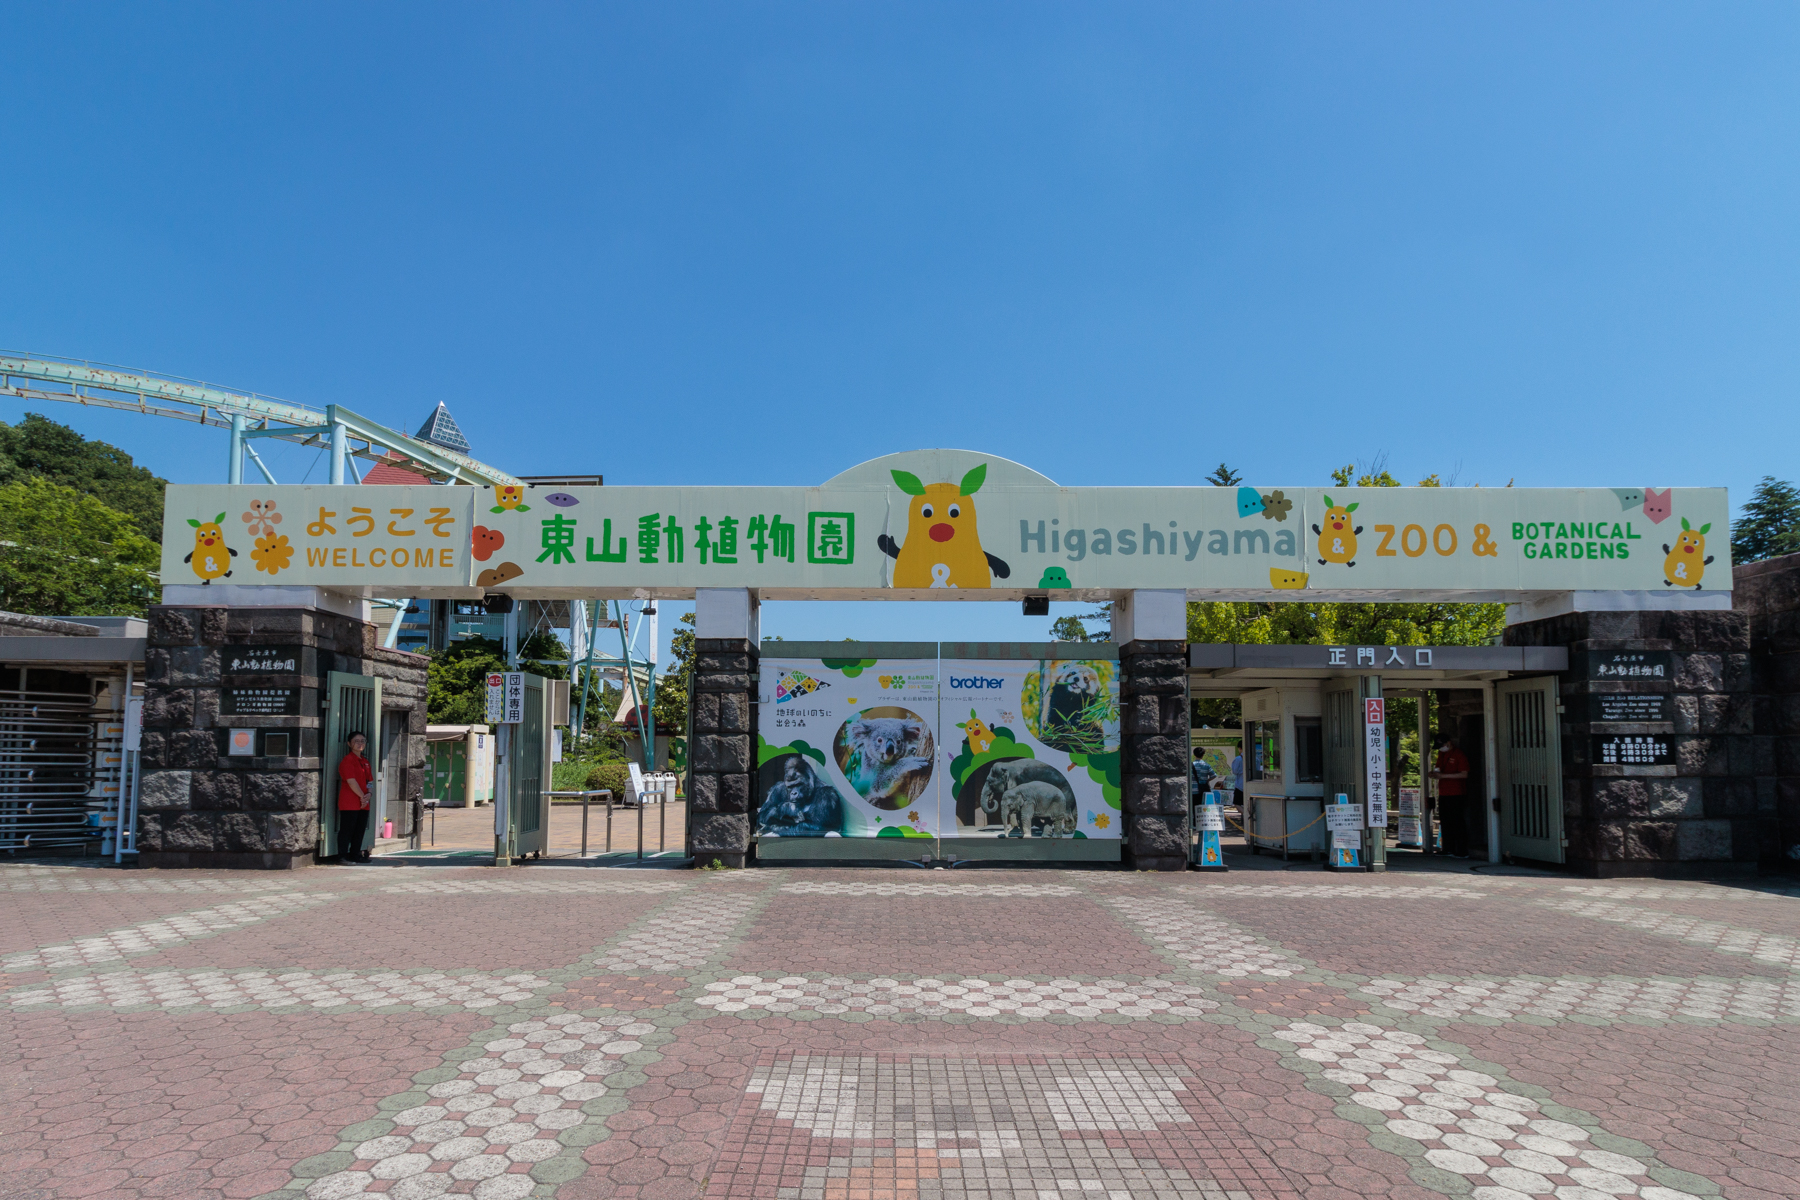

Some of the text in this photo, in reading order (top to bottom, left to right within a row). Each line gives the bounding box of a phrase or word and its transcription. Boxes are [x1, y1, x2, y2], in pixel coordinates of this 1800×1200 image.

[306, 506, 456, 538] ようこそ
[1511, 522, 1642, 540] BOTANICAL
[535, 511, 855, 564] 東山動植物園
[1019, 518, 1499, 562] Higashiyama ZOO &
[306, 548, 455, 568] WELCOME
[1523, 541, 1631, 560] GARDENS
[230, 658, 295, 671] 東山動植物園
[1328, 646, 1432, 666] 正門入口
[1597, 664, 1664, 676] 東山動植物園
[950, 676, 1004, 688] brother
[509, 674, 520, 721] 団体専用
[776, 708, 832, 717] 地球のいのちに
[1369, 701, 1381, 722] 入口
[776, 719, 807, 727] 出会う森
[1370, 727, 1383, 824] 幼児、小・中学生無料
